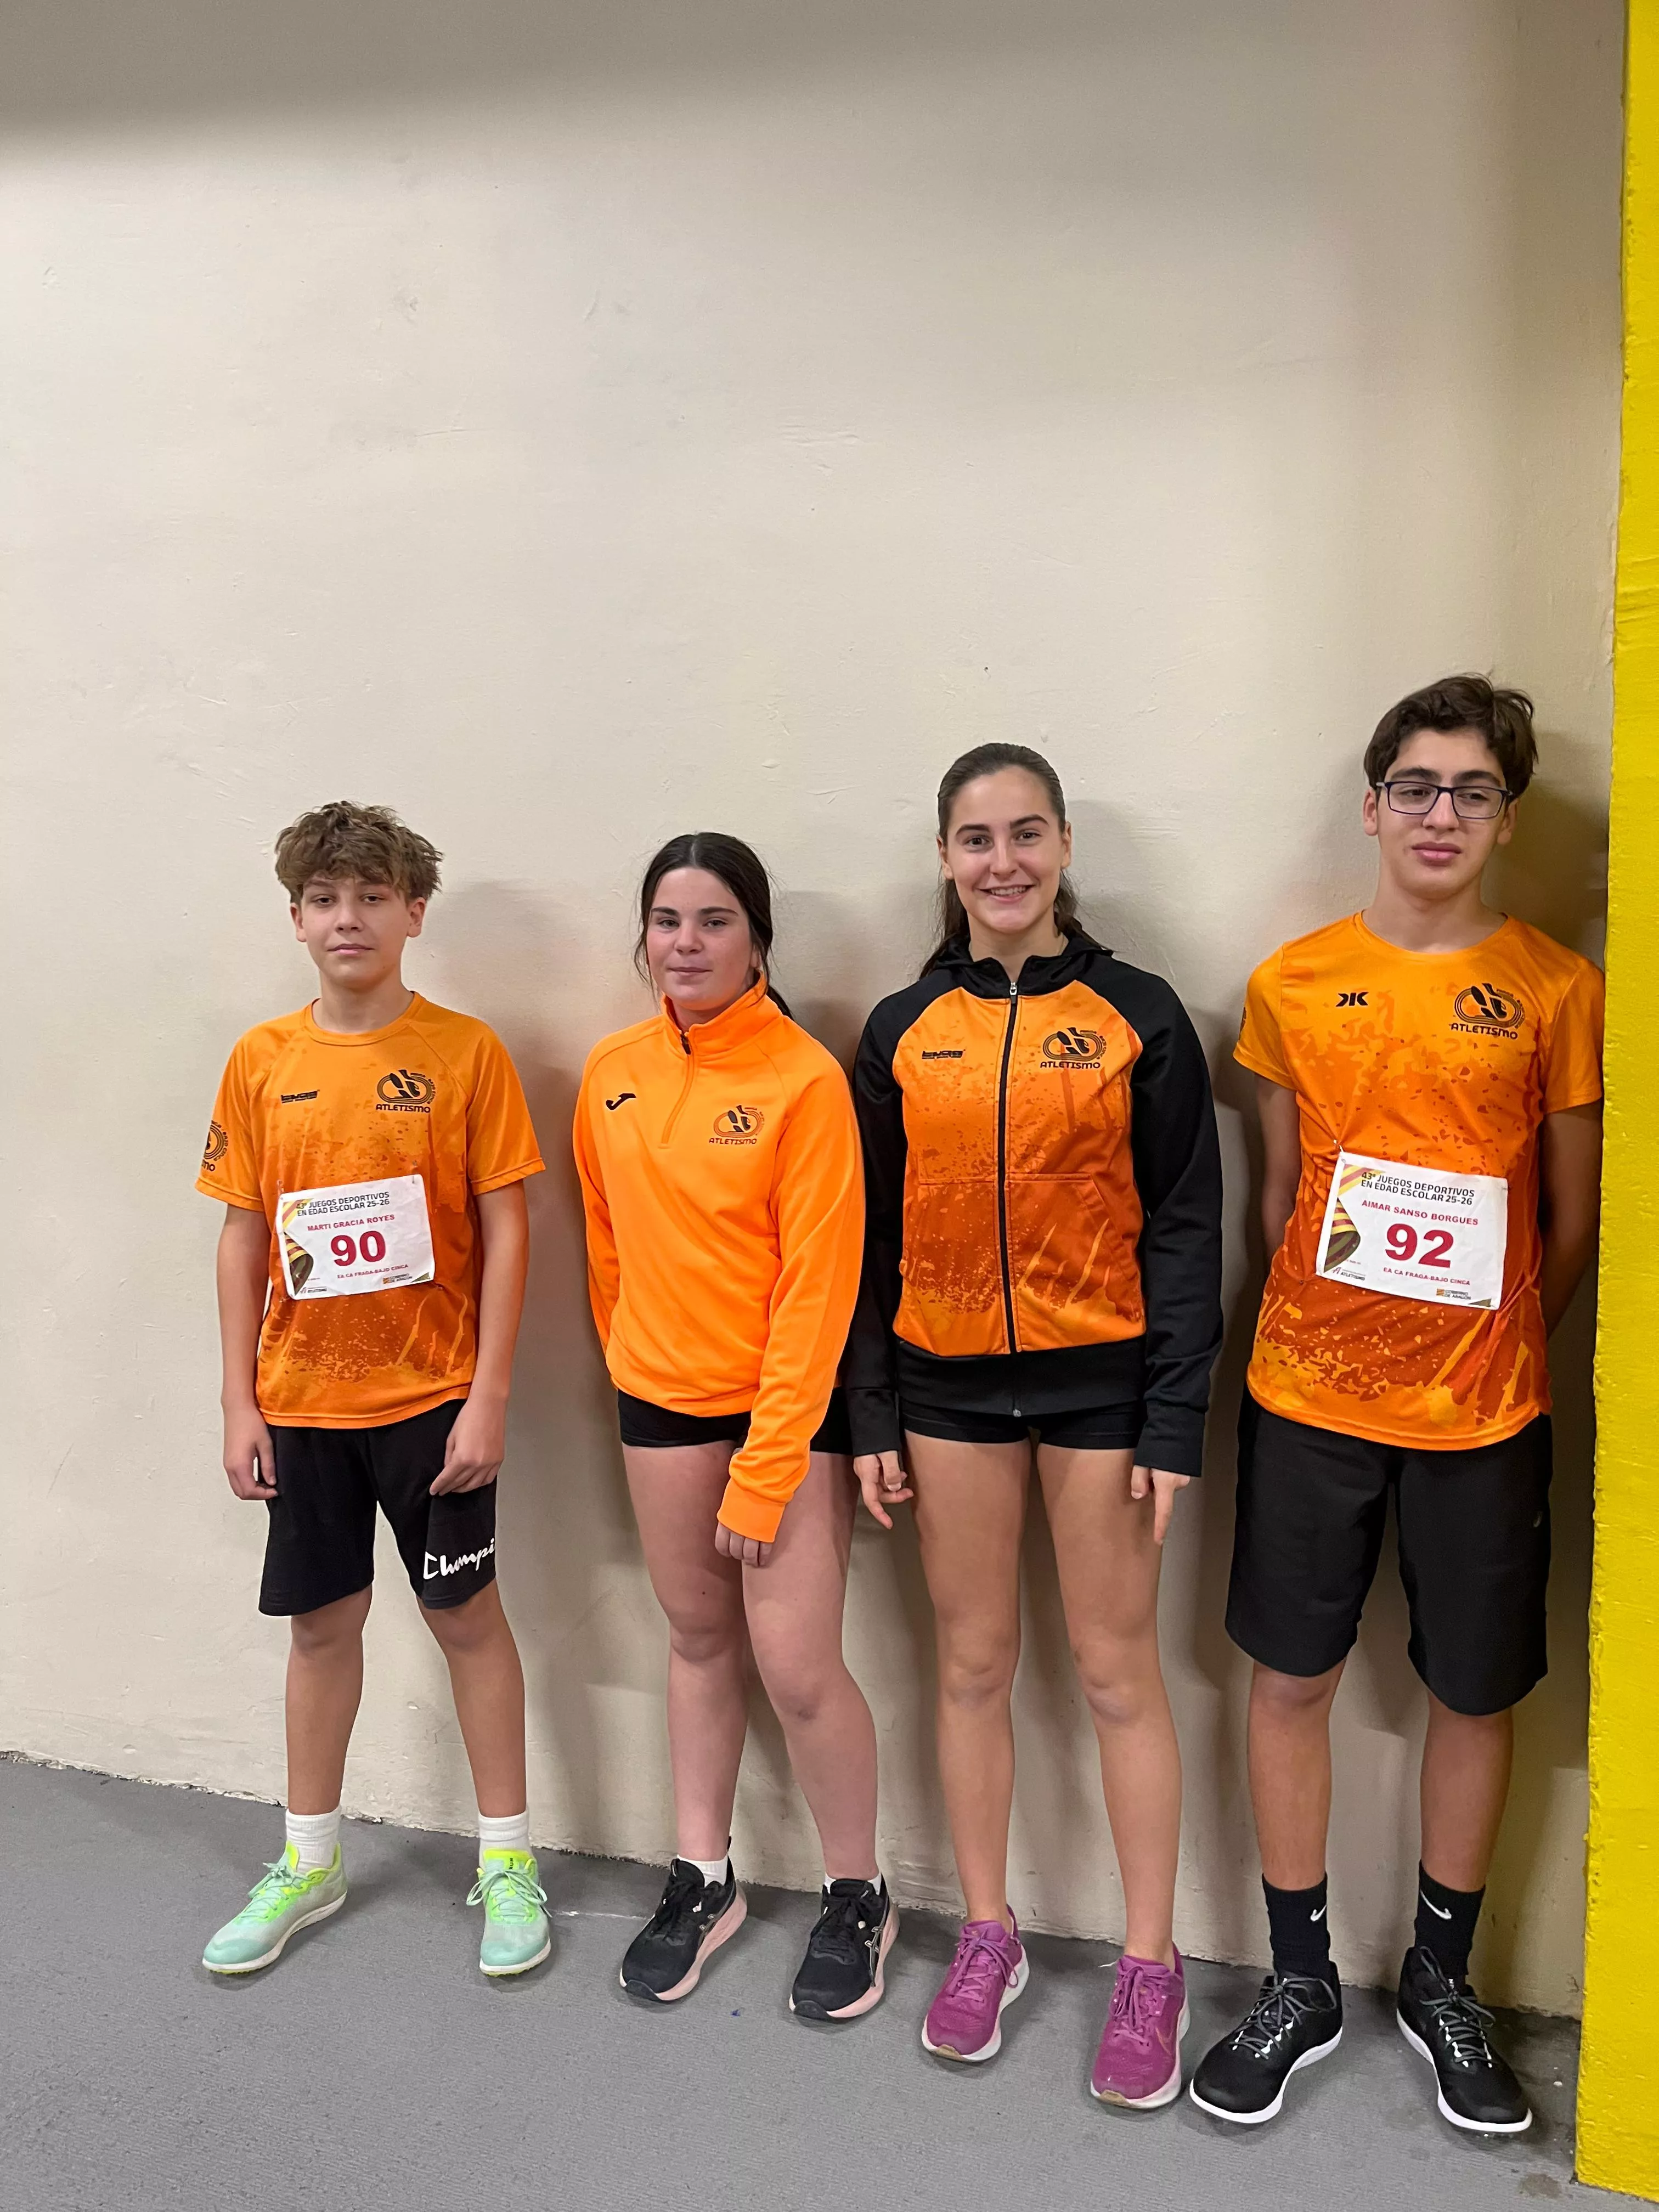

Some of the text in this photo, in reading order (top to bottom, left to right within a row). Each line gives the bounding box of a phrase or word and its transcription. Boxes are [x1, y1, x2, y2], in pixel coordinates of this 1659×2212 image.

[1451, 1023, 1518, 1039] ATLETISMO
[376, 1104, 431, 1113] ATLETISMO
[1361, 1180, 1472, 1205] EN EDAD ESCOLAR 25-26
[1377, 1175, 1412, 1188] JUEGOS
[1414, 1182, 1475, 1197] DEPORTIVOS
[308, 1207, 328, 1215] EDAD
[330, 1202, 365, 1212] ESCOLAR
[367, 1199, 390, 1207] 25-26
[309, 1199, 336, 1208] JUEGOS
[338, 1192, 390, 1204] DEPORTIVOS
[333, 1219, 364, 1228] GRACIA
[367, 1215, 395, 1223] ROYES
[1362, 1200, 1479, 1226] AIMAR SANSO BORGUES
[330, 1231, 386, 1266] 90
[1385, 1223, 1454, 1268] 92
